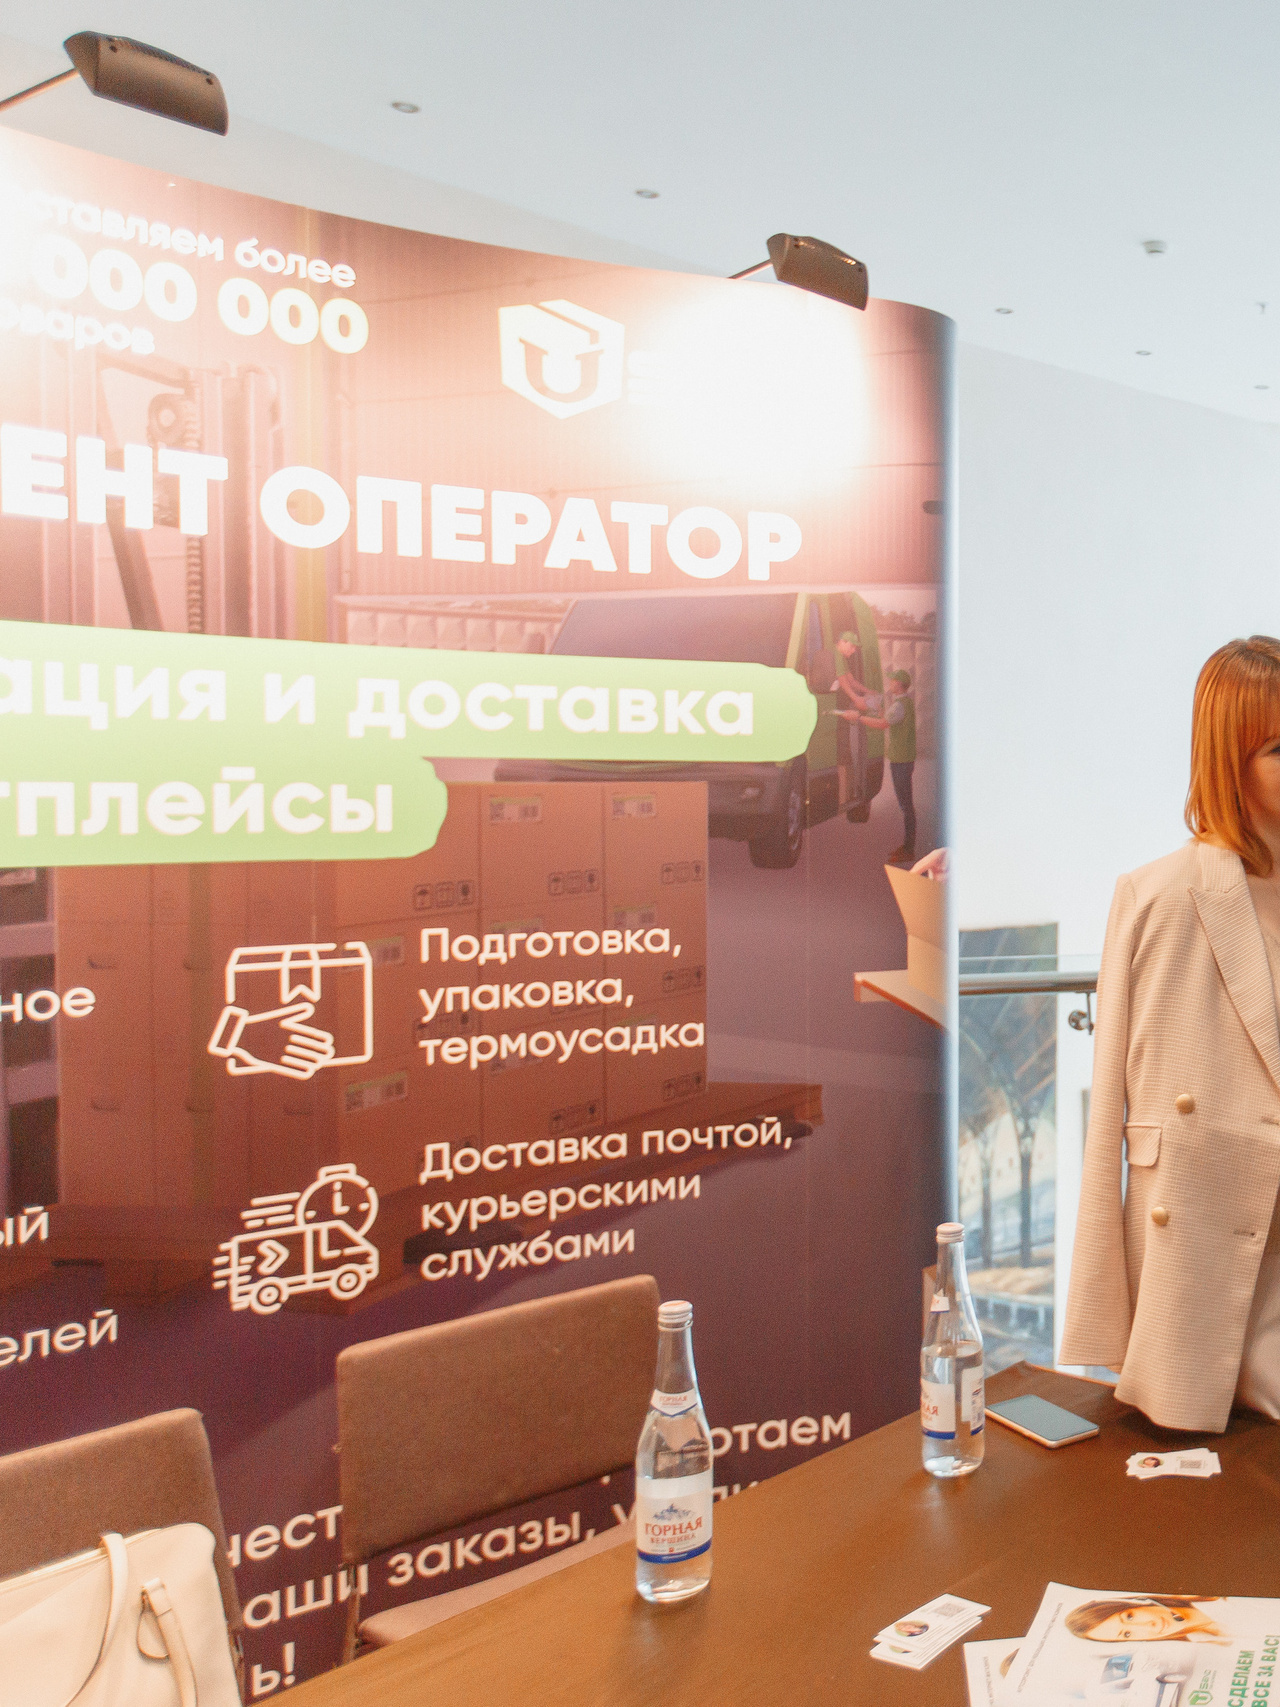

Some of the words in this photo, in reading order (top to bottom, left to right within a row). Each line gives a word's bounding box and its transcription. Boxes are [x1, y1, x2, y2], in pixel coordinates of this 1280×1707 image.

[234, 238, 357, 288] более
[217, 277, 370, 354] 000
[0, 425, 229, 537] ЕНТ
[259, 465, 803, 582] ОПЕРАТОР
[263, 672, 316, 725] и
[347, 676, 755, 739] доставка
[420, 926, 682, 966] Подготовка,
[418, 976, 635, 1023] упаковка,
[418, 1021, 706, 1071] термоусадка
[419, 1131, 628, 1185] Доставка
[641, 1116, 793, 1156] почтой,
[420, 1173, 702, 1236] курьерскими
[419, 1227, 636, 1282] службами
[387, 1510, 596, 1588] заказы,
[644, 1516, 703, 1536] ГОРНАЯ
[1257, 1663, 1276, 1677] ЗА
[1264, 1634, 1280, 1662] ВАС!
[1227, 1650, 1255, 1707] СДЕЛАЕМ
